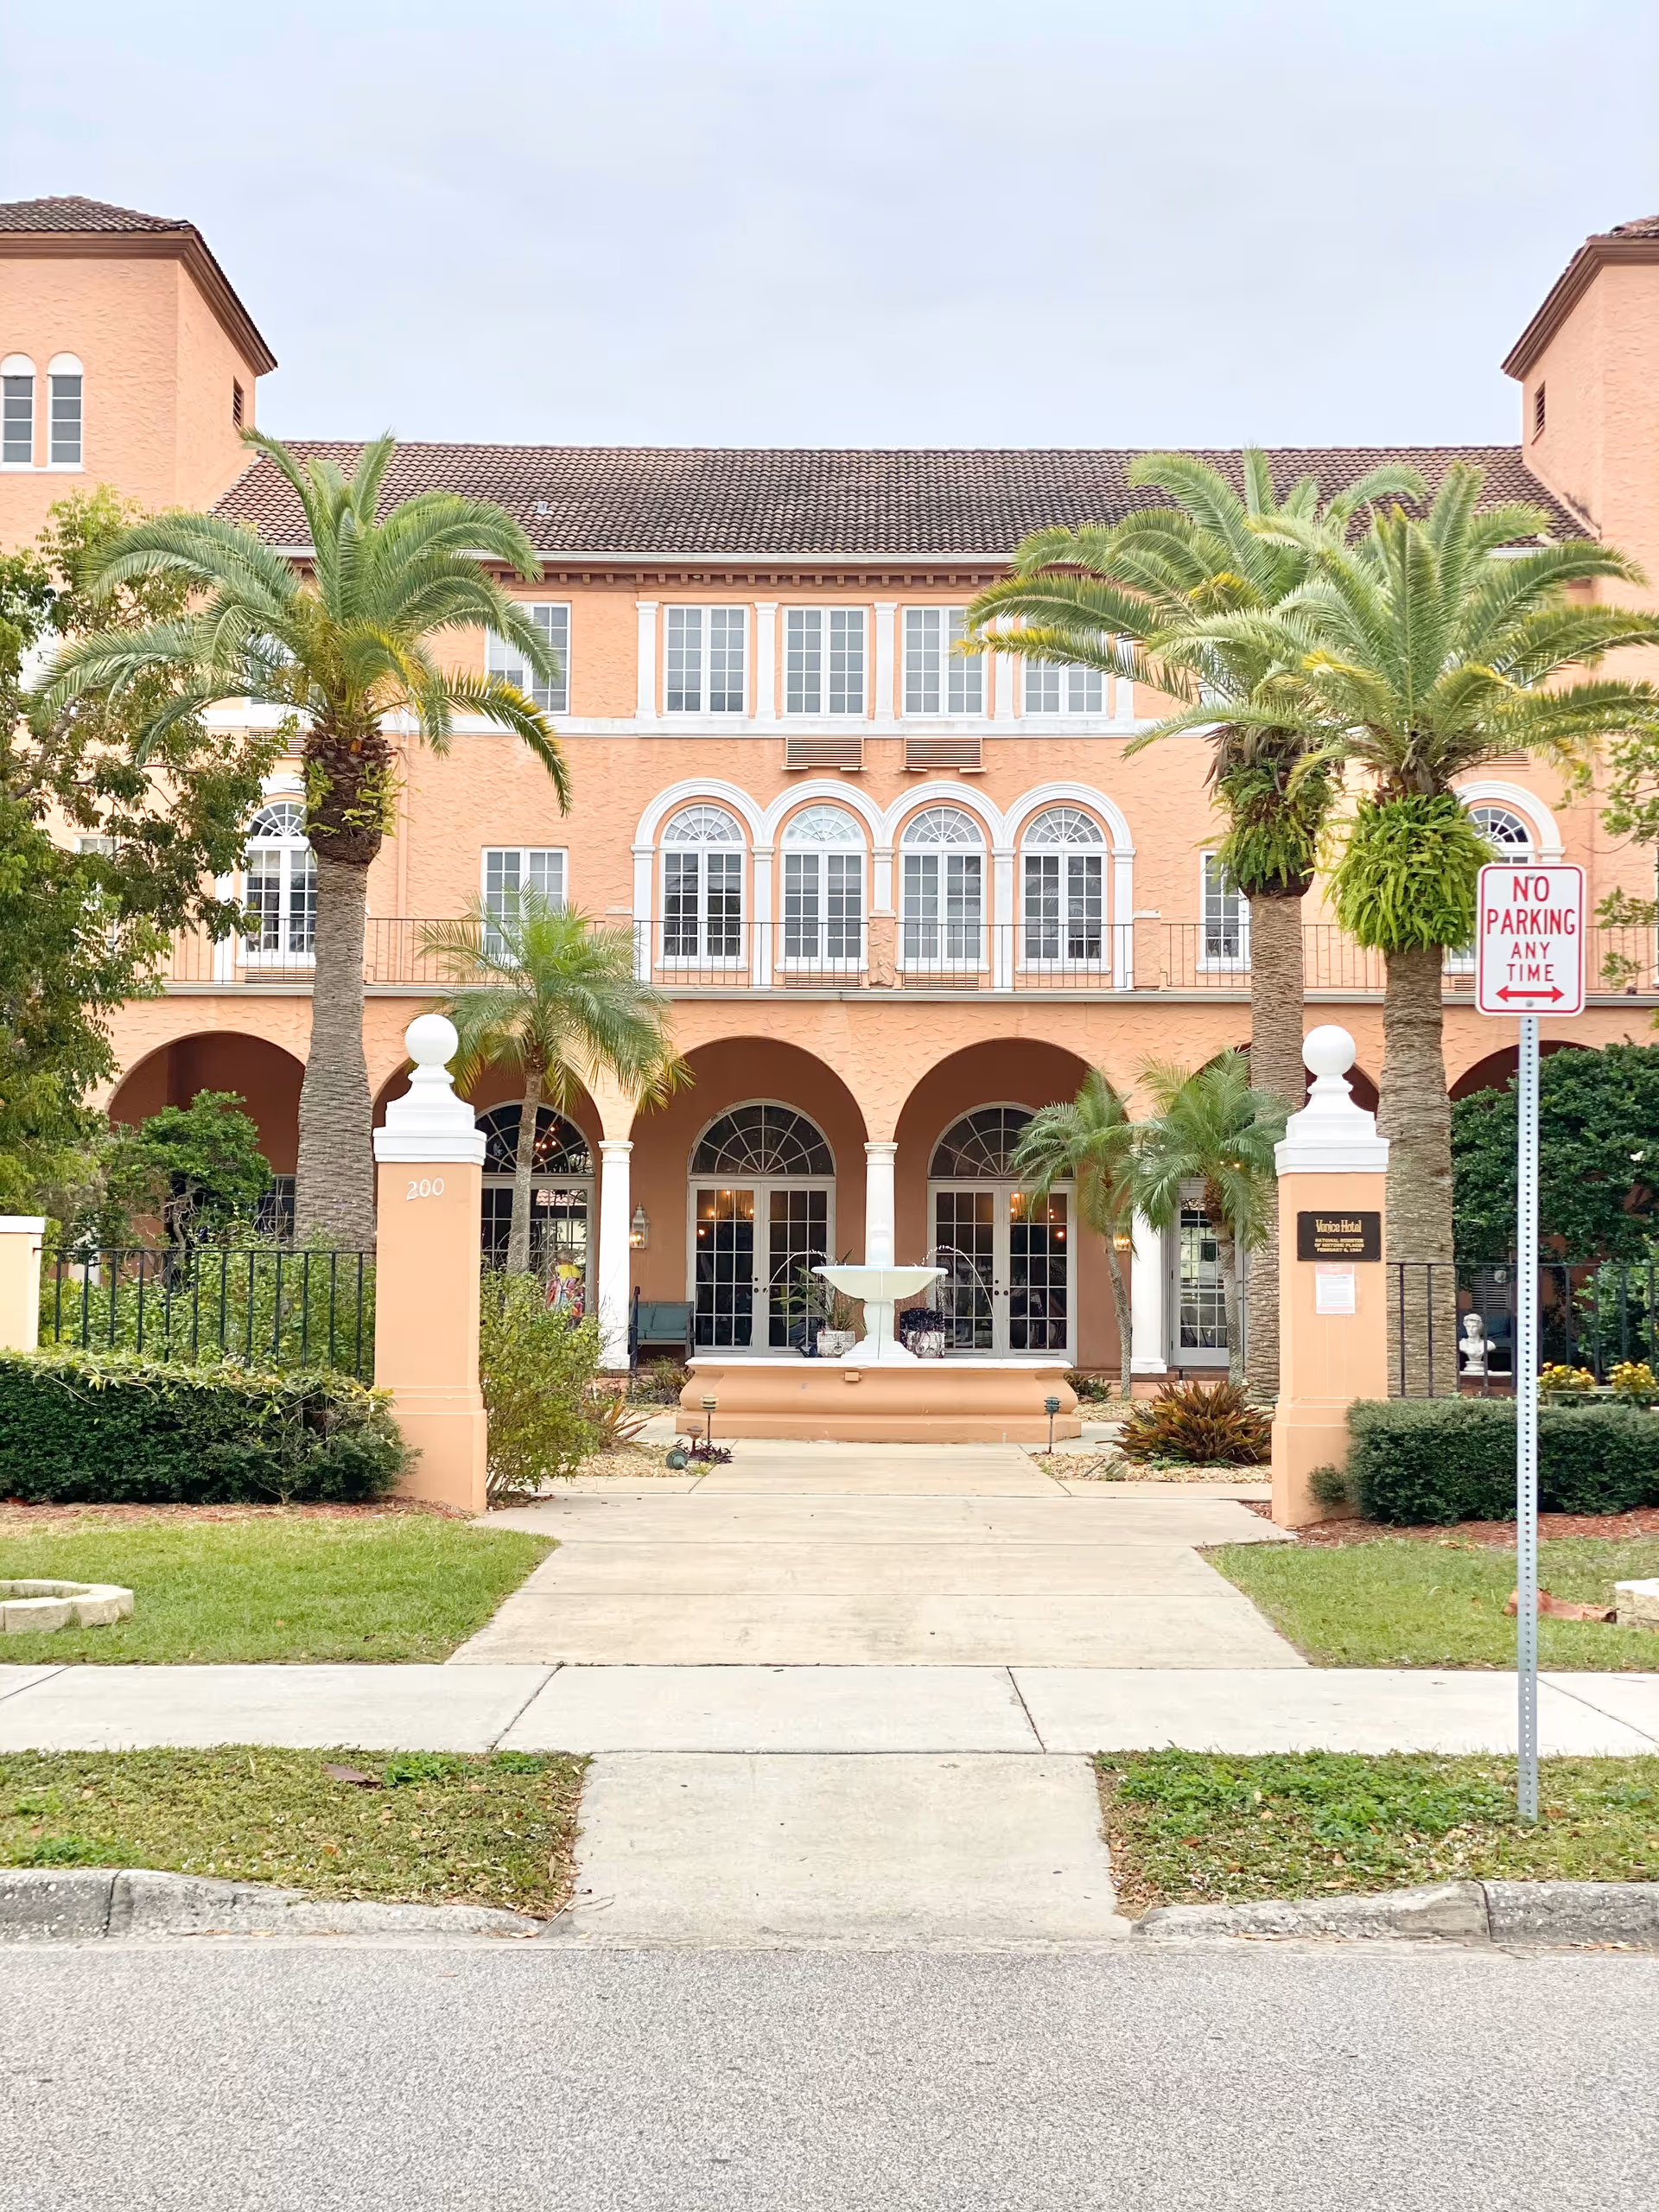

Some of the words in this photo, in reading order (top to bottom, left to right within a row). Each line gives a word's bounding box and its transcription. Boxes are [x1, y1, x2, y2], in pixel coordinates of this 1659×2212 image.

[1513, 875, 1549, 901] NO
[1487, 909, 1575, 935] PARKING
[1510, 942, 1550, 959] ANY
[1507, 964, 1554, 982] TIME
[406, 1178, 445, 1201] 200
[1315, 1219, 1340, 1233] Venice
[1340, 1219, 1362, 1233] Hotel
